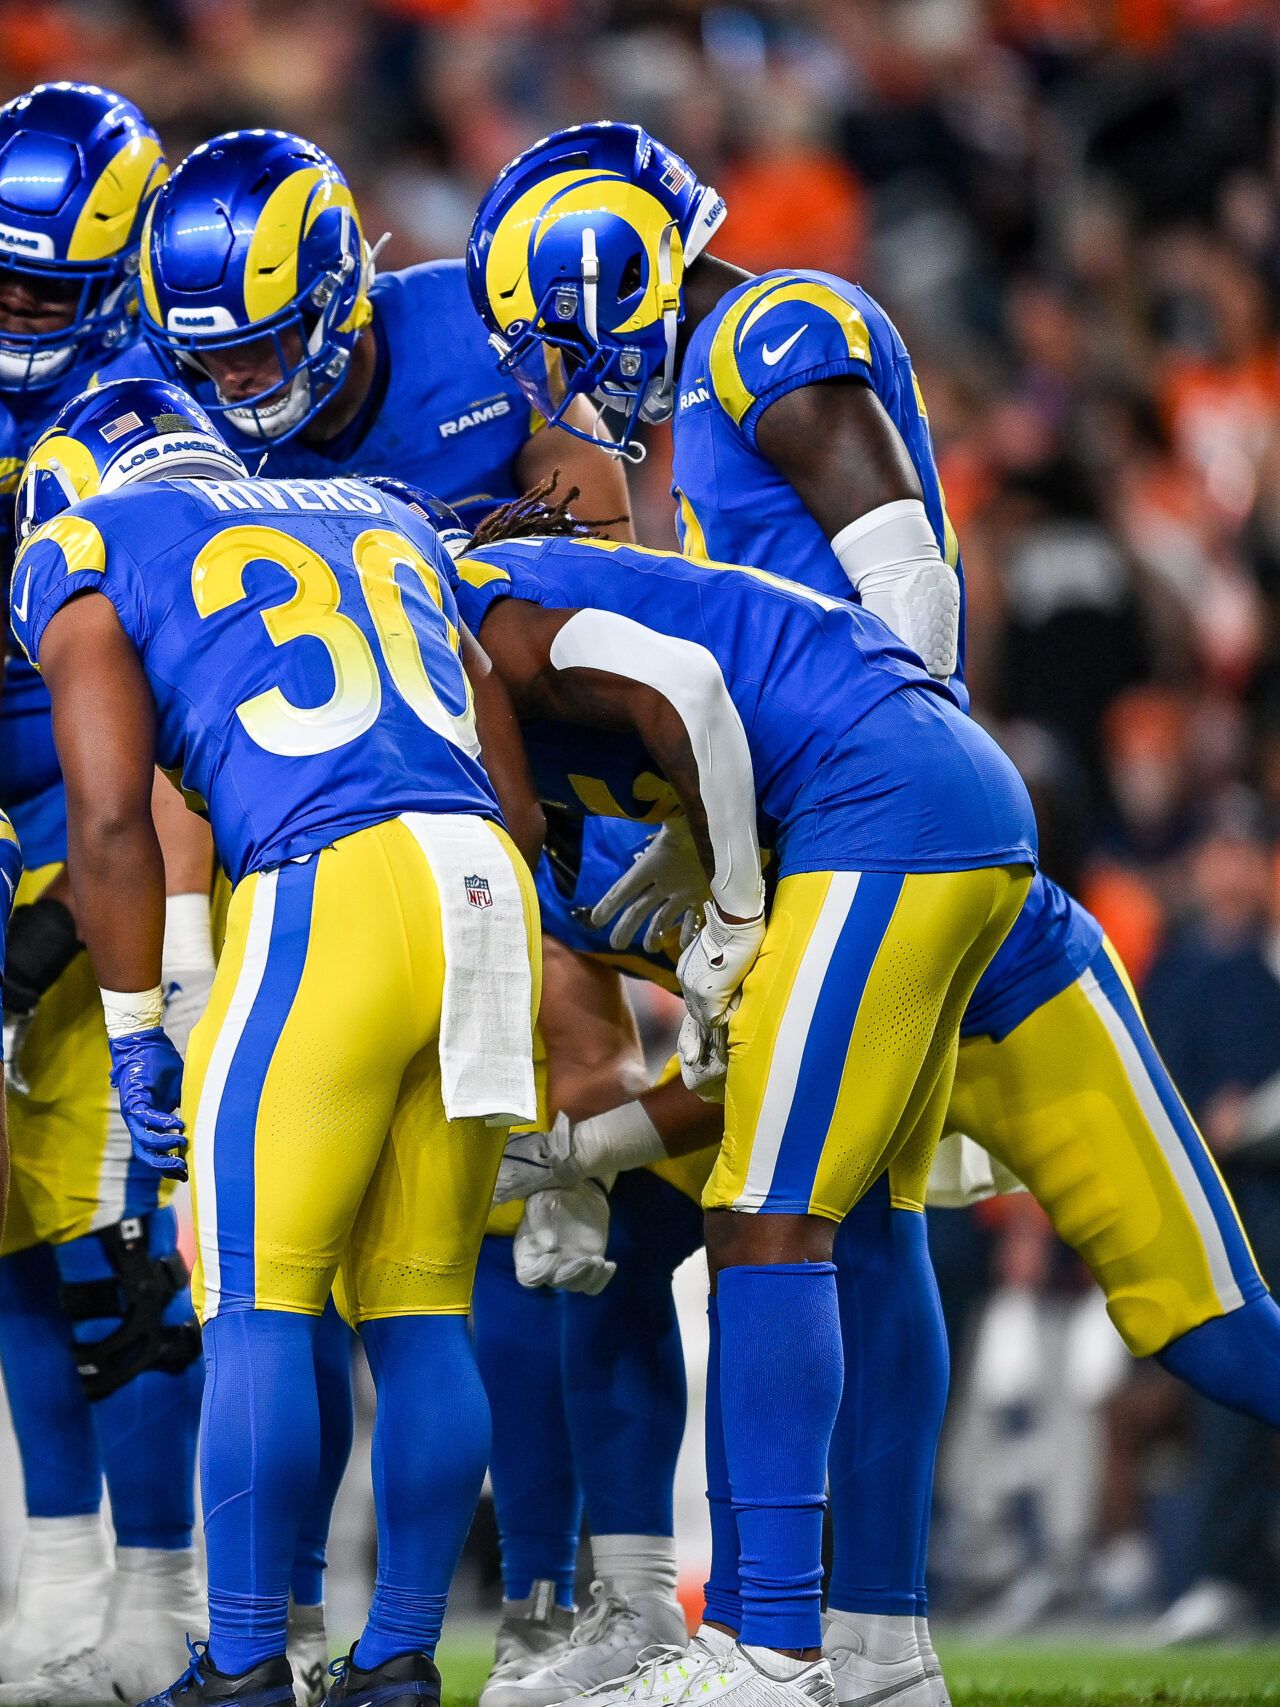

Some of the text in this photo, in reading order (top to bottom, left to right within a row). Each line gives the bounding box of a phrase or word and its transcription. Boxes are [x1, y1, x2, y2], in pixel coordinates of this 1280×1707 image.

[680, 387, 711, 411] RAM
[439, 400, 511, 438] RAMS
[118, 447, 160, 474] LOS
[189, 478, 383, 515] RIVERS
[191, 525, 482, 759] 30
[468, 889, 491, 907] NFL
